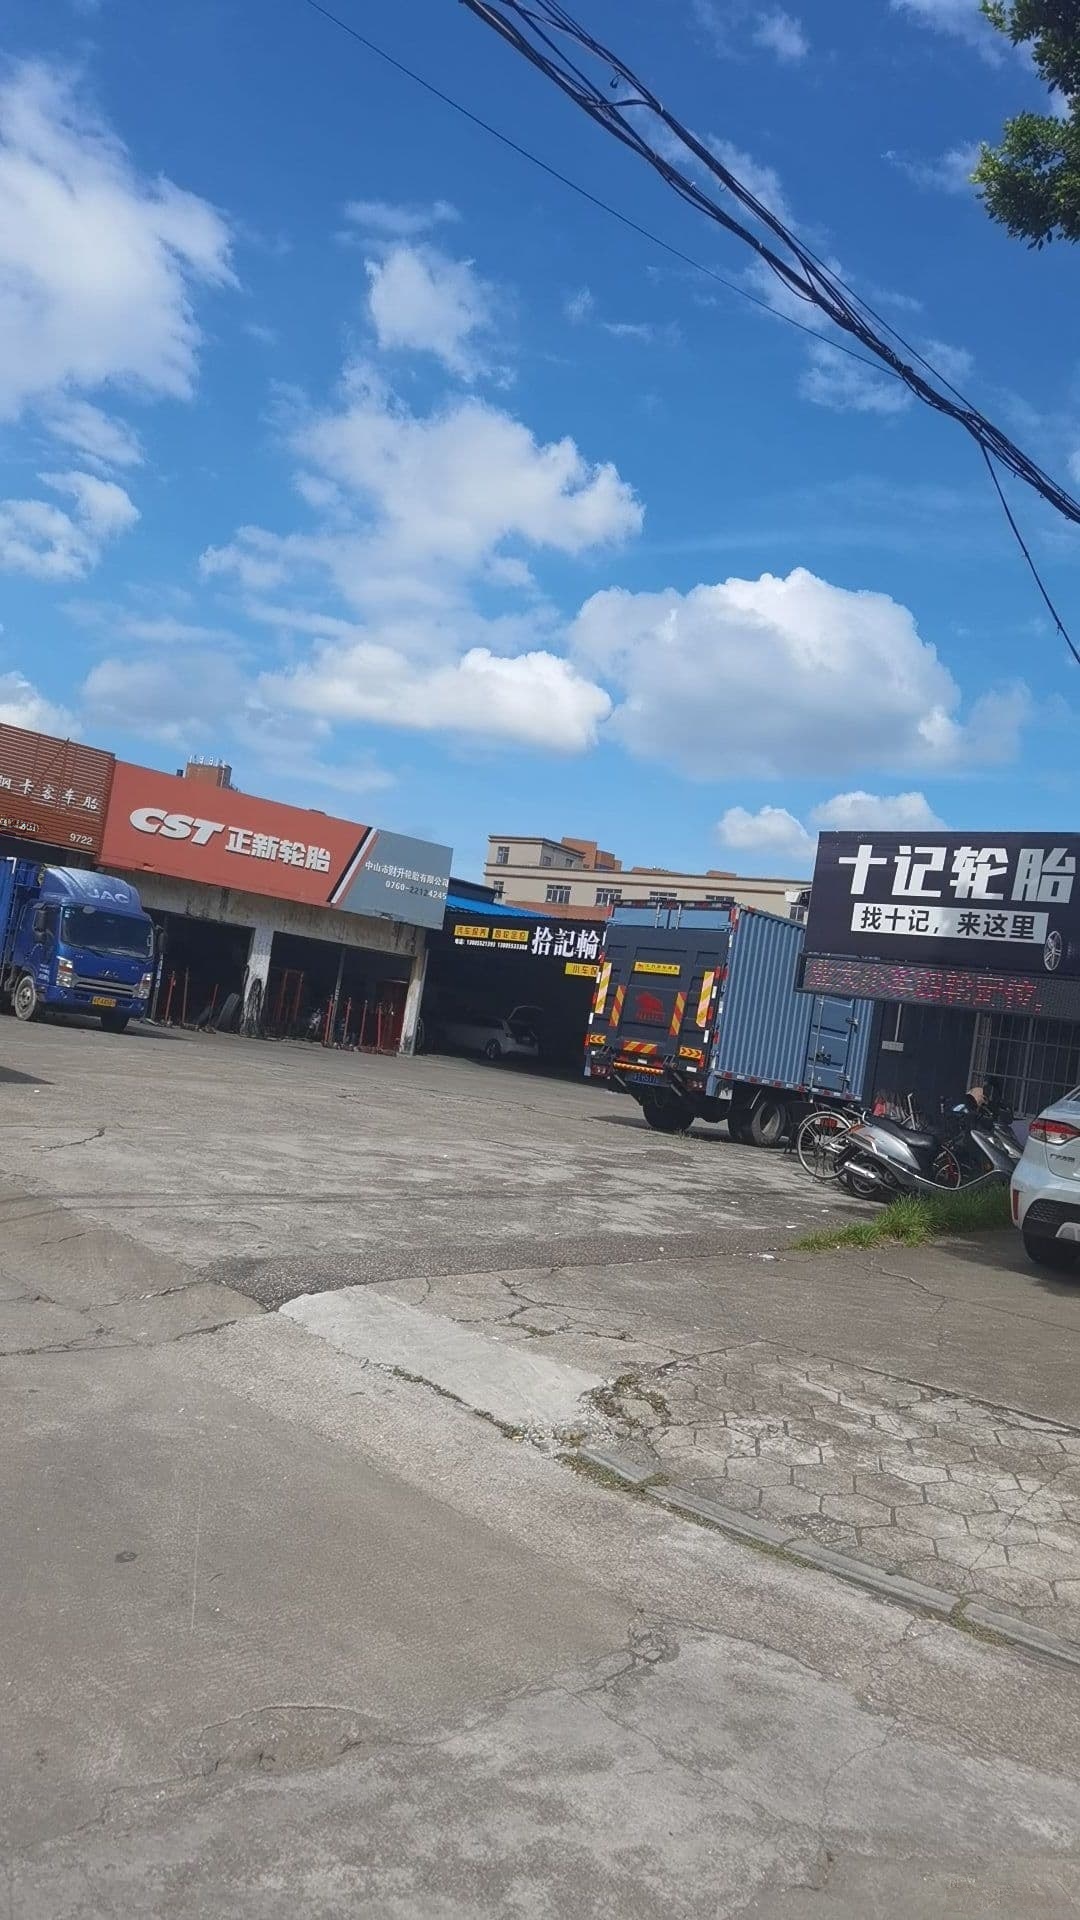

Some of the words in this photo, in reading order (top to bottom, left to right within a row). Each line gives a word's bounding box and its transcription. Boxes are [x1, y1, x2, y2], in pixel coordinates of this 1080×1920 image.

[70, 833, 93, 845] 9722
[129, 807, 226, 845] CST
[224, 826, 331, 873] 正新轮胎
[838, 844, 1076, 904] 十记轮胎
[87, 888, 129, 904] JAC
[531, 925, 606, 960] 拾記輪
